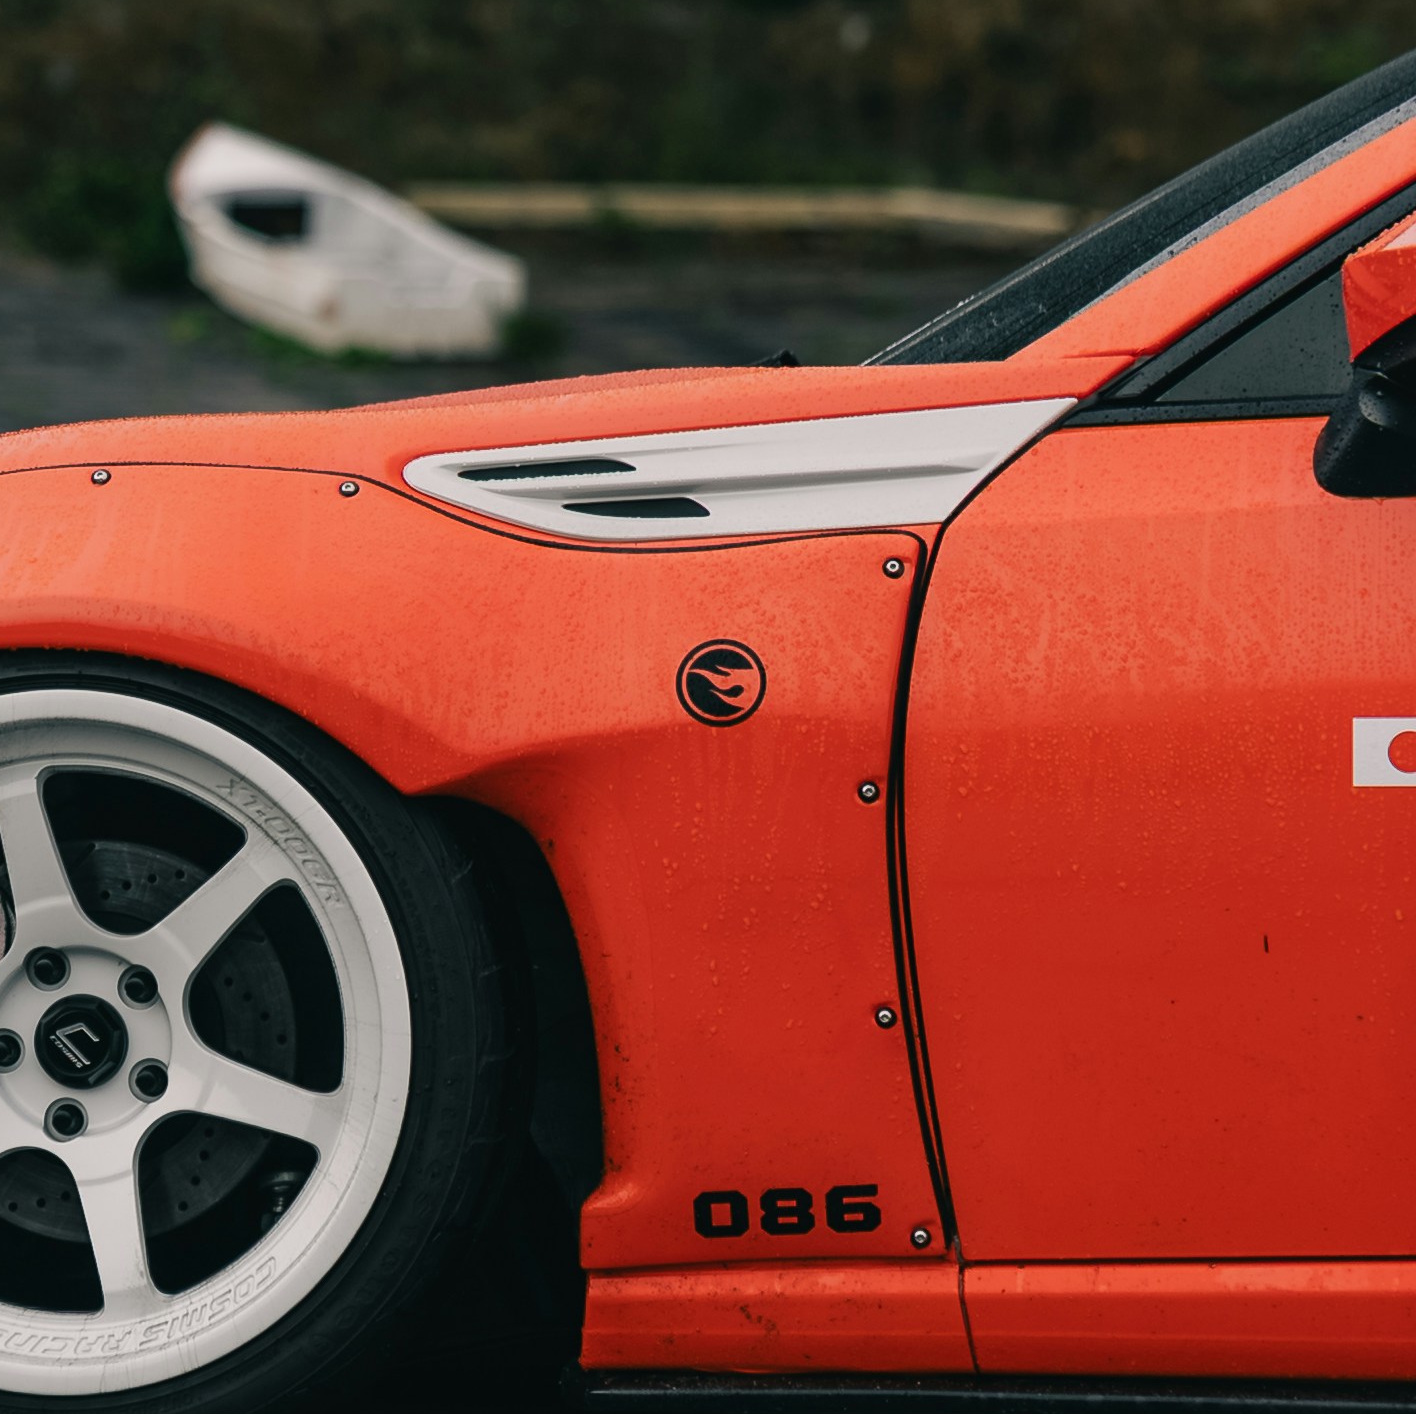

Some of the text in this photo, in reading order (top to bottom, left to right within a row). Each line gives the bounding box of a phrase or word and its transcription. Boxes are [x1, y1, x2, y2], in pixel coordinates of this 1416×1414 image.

[48, 1034, 84, 1069] COSMIS
[692, 1183, 883, 1240] 086
[138, 1255, 278, 1347] COSMIS
